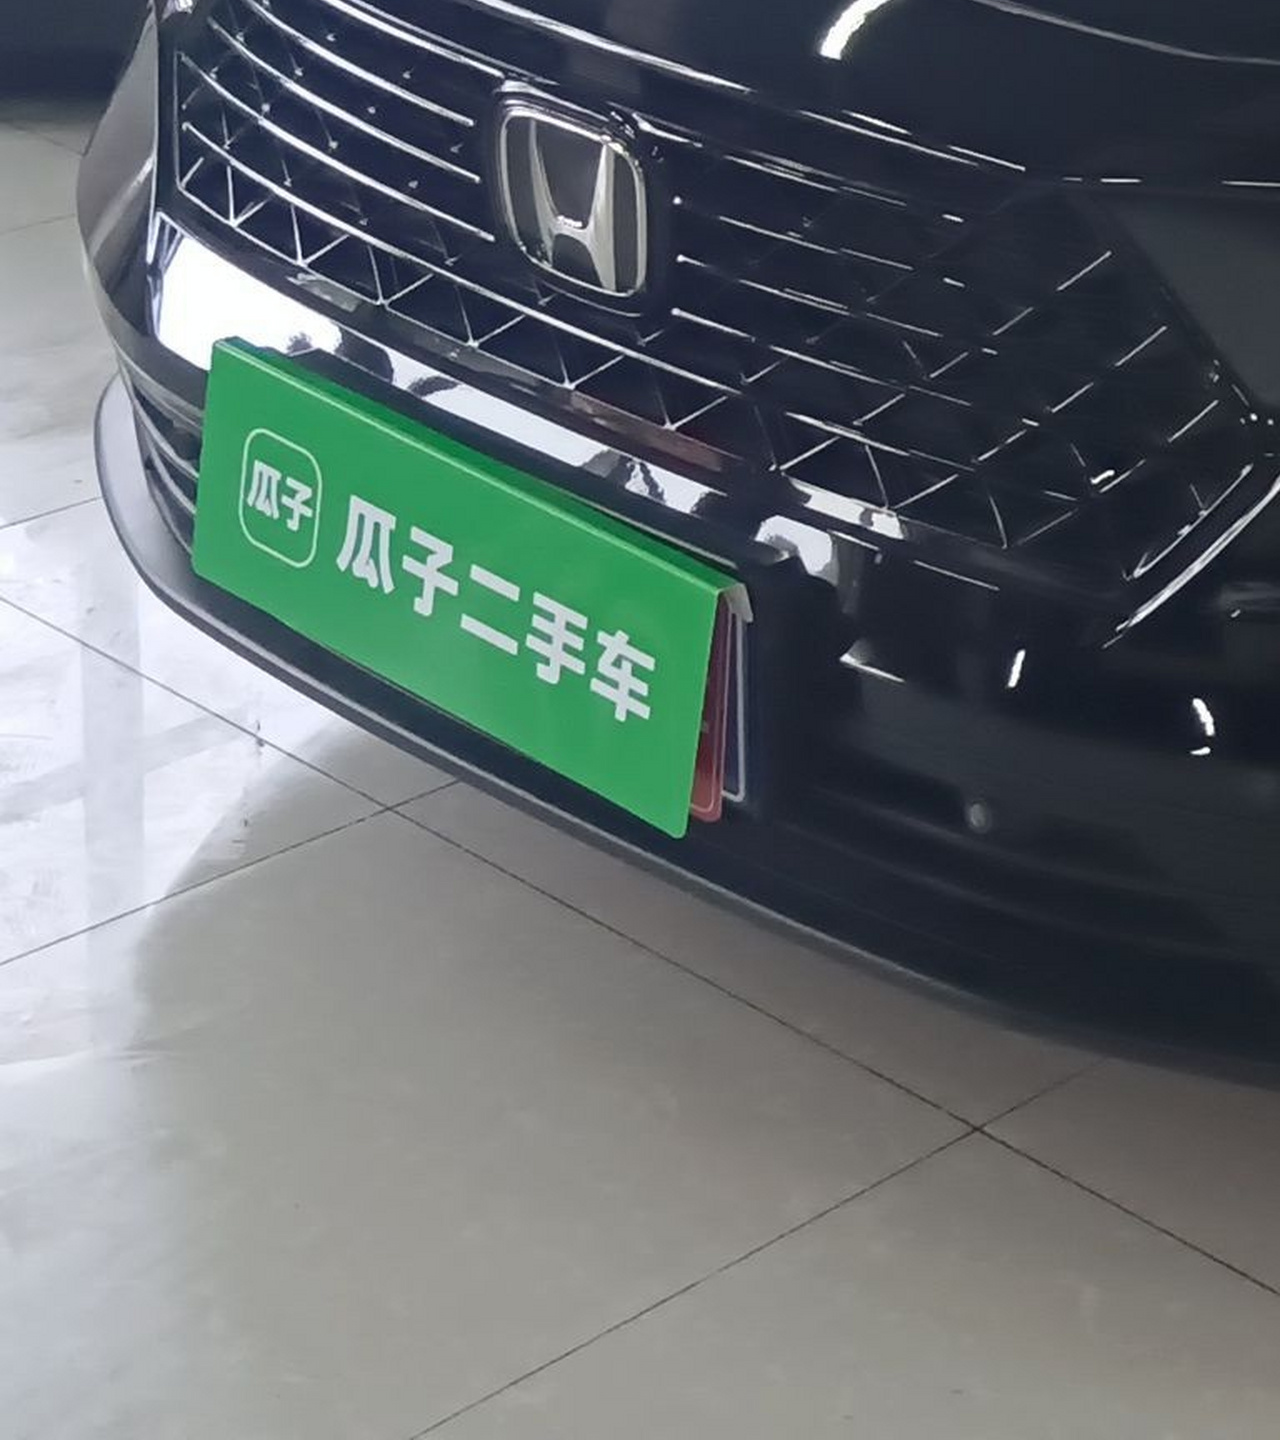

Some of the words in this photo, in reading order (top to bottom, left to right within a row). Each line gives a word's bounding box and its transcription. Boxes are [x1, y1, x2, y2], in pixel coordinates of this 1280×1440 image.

[247, 459, 314, 532] 瓜子
[337, 495, 656, 723] 瓜子二手车
